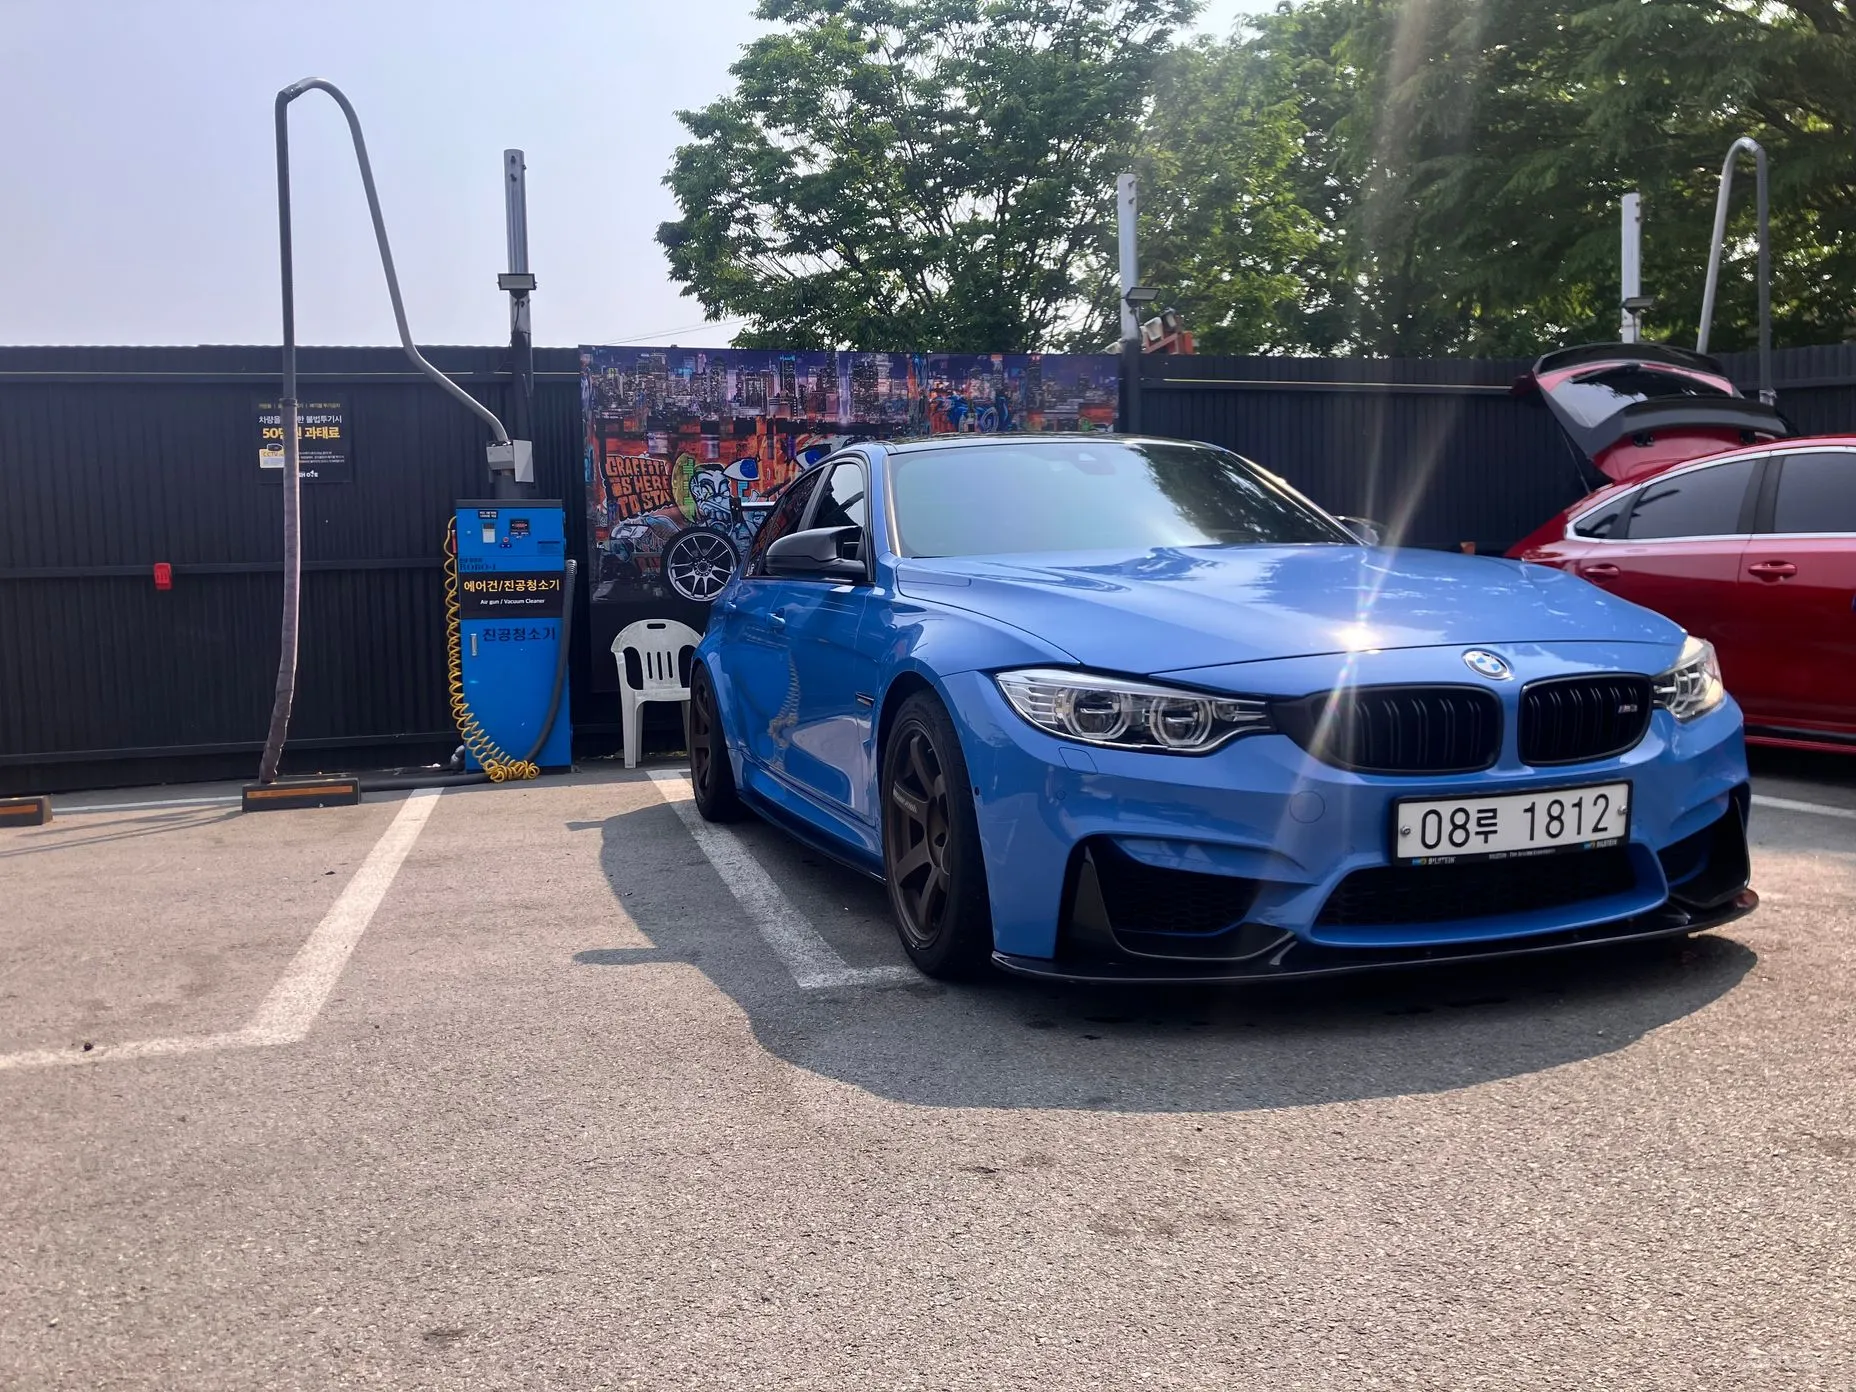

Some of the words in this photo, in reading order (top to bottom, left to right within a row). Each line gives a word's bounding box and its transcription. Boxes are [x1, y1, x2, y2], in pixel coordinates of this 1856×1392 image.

[304, 426, 341, 439] 과태료
[633, 475, 671, 493] HERE
[617, 495, 641, 518] TO
[463, 579, 560, 593] 에어건/진공청소기
[482, 627, 556, 642] 진공청소기
[1420, 808, 1498, 850] 08루
[1523, 794, 1610, 841] 1812
